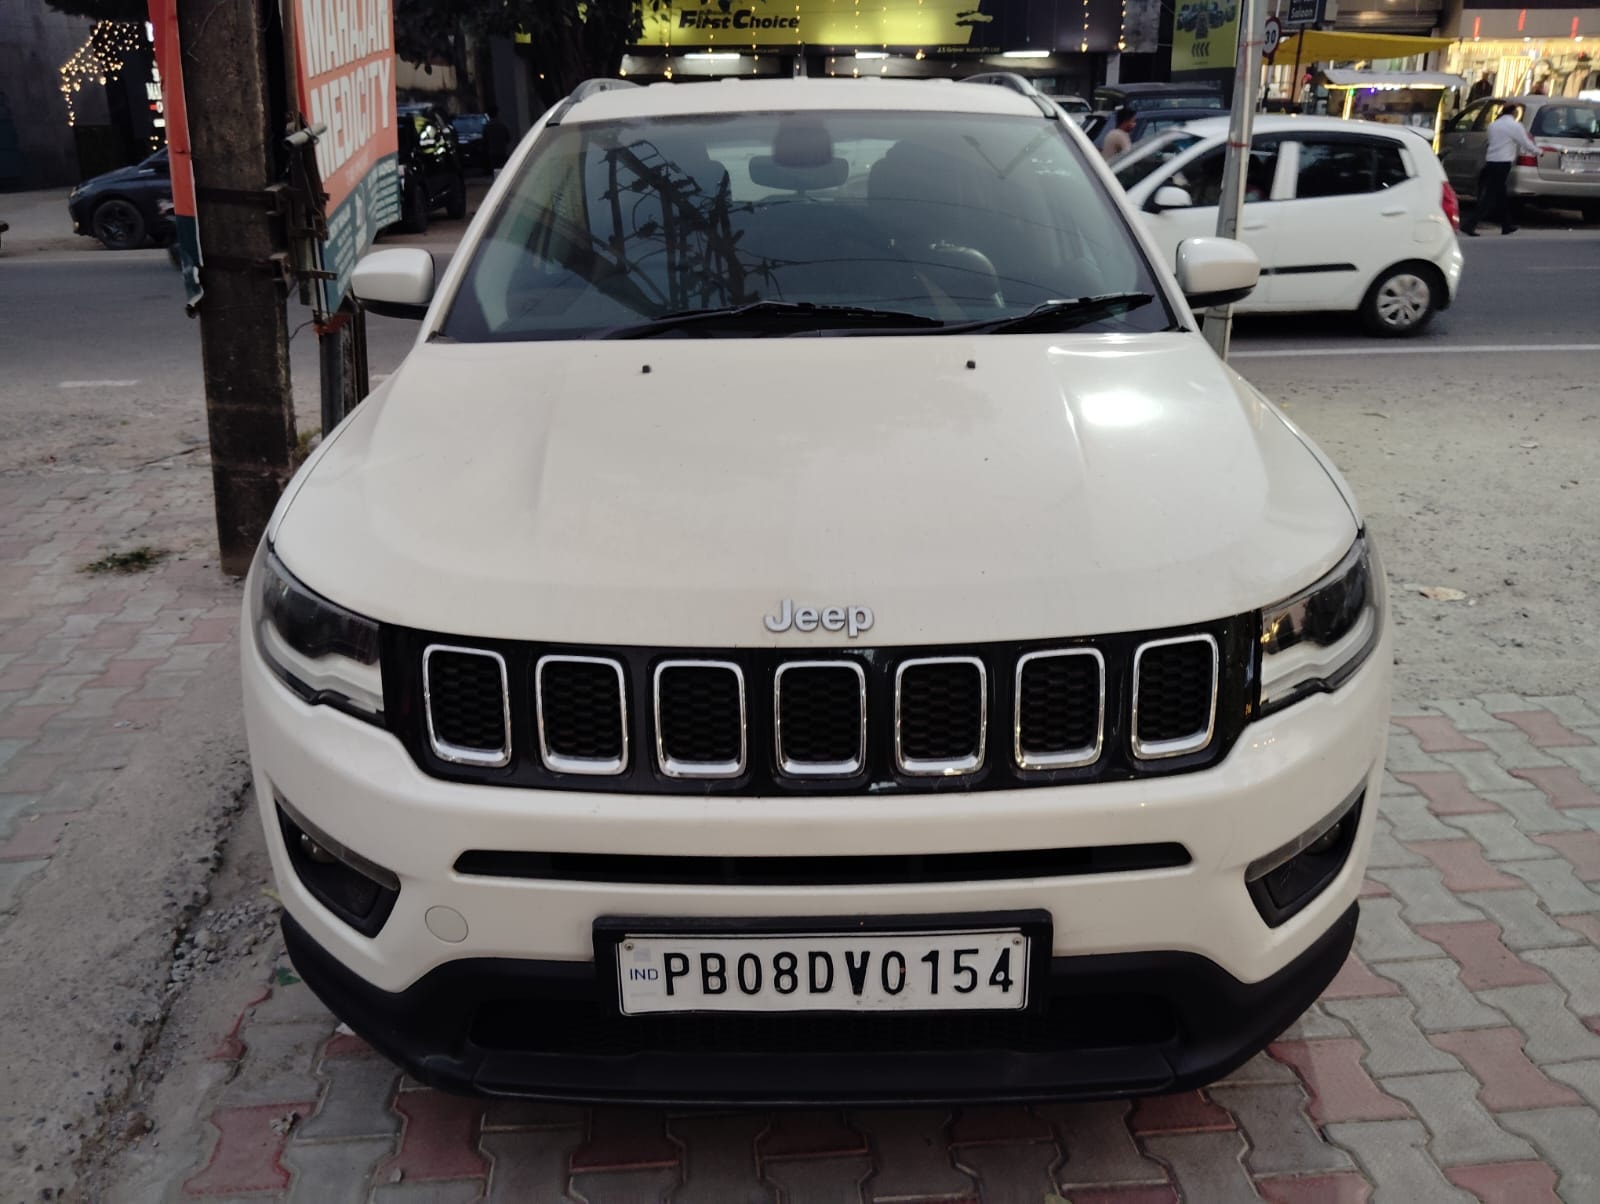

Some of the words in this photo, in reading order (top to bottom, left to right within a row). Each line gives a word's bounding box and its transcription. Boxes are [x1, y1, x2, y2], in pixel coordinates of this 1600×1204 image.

[303, 0, 389, 78] MAHAJAN
[1264, 29, 1277, 44] 30
[310, 58, 390, 183] MEDICITY
[764, 599, 874, 638] Jeep
[629, 968, 659, 981] IND
[664, 948, 1013, 996] PB08DV0154
